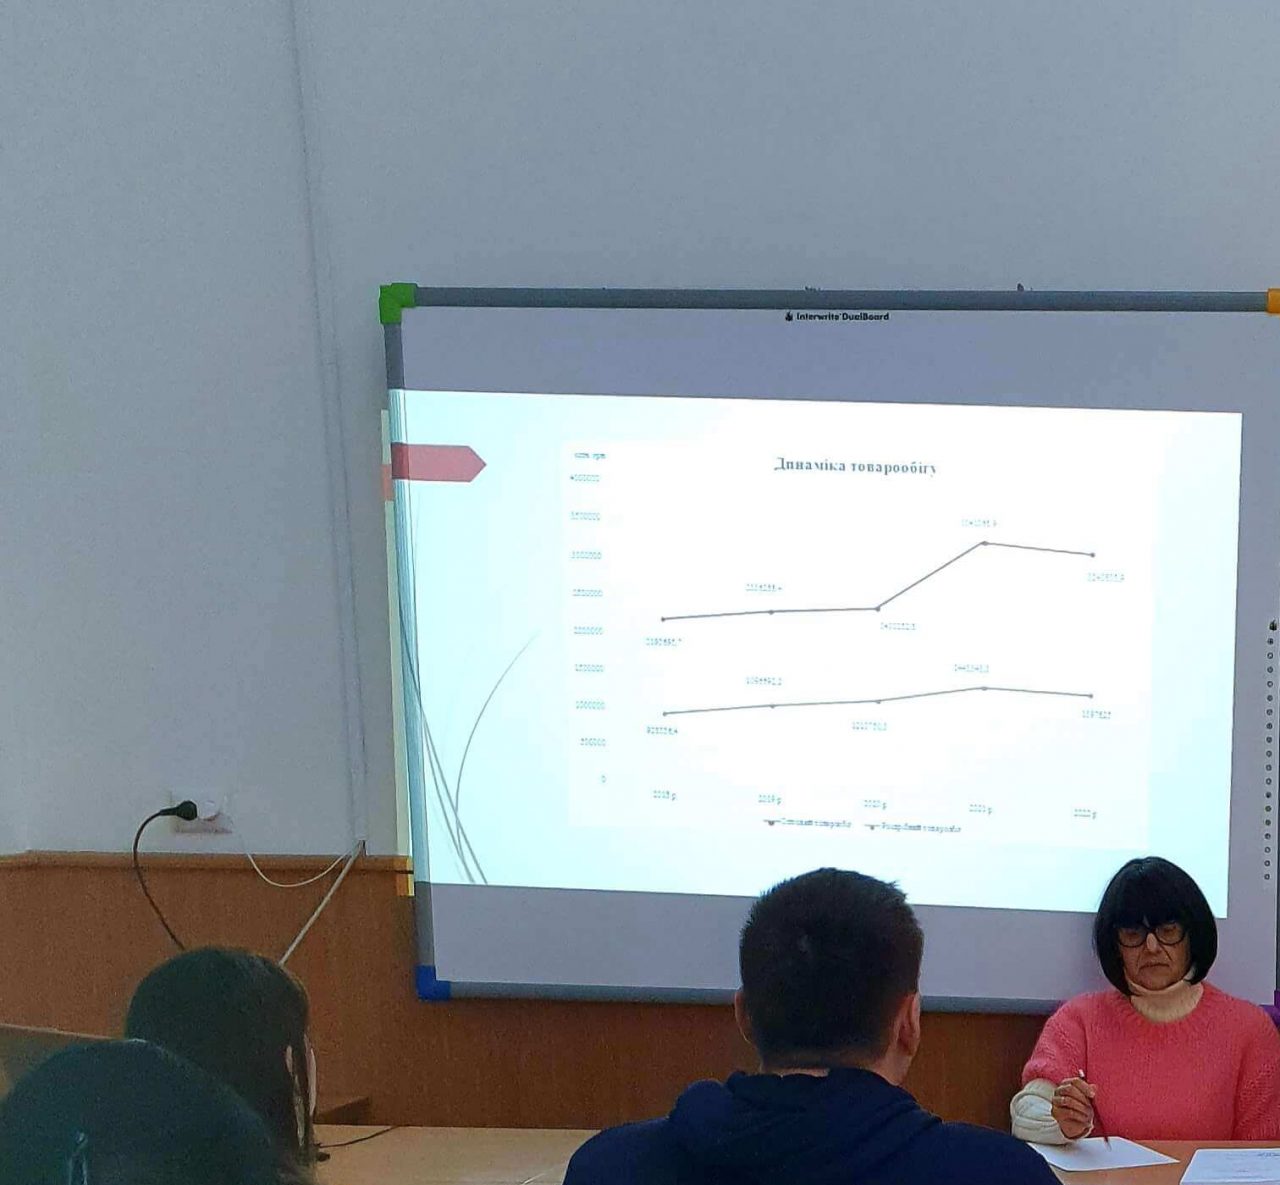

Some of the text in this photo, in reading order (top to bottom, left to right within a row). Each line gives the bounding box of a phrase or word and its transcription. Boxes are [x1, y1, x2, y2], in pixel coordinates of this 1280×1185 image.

[797, 312, 890, 321] Interwrite DualBoard
[774, 457, 937, 478] Динаміка товарообігу
